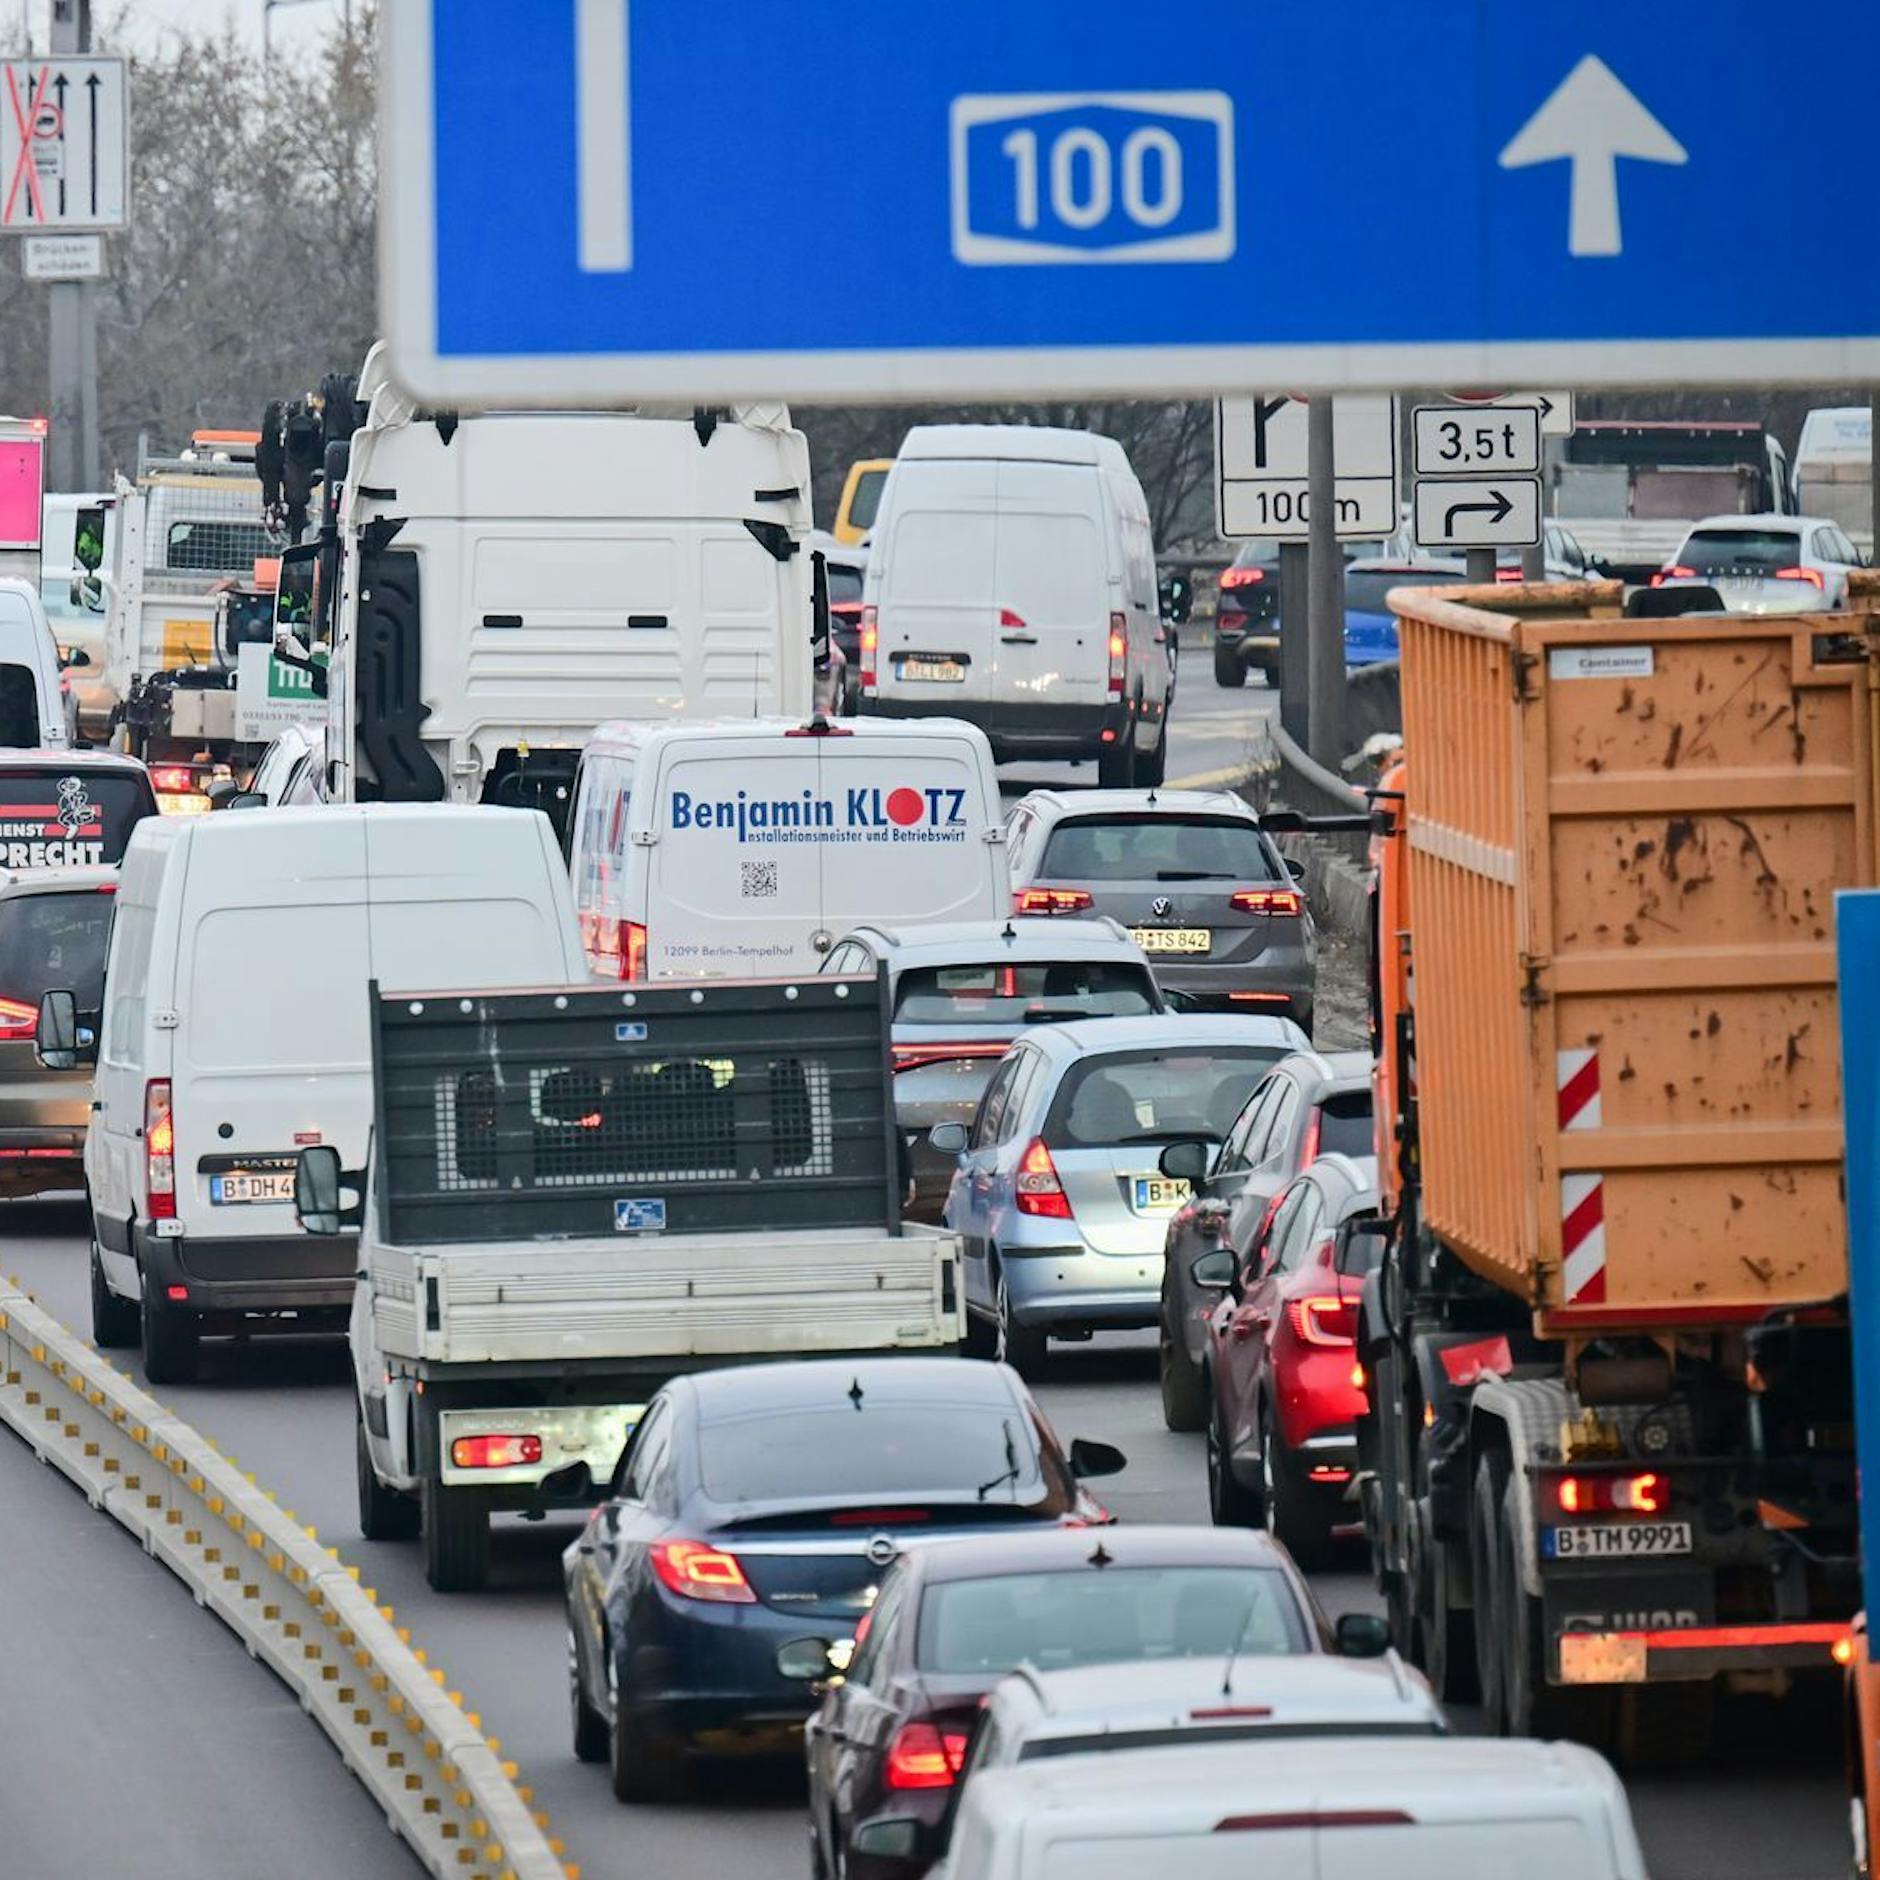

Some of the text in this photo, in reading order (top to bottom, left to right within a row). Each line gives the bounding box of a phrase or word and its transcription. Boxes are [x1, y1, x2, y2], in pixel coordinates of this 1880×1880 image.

[1002, 126, 1183, 230] 100
[672, 790, 833, 842] Benjamin
[866, 829, 888, 842] und
[893, 828, 965, 842] Betriebswirt
[1156, 933, 1175, 947] TS
[1178, 932, 1207, 947] 842
[702, 945, 794, 960] Berlin-Tempelhof
[224, 1181, 236, 1198] B
[251, 1179, 276, 1197] DH
[1150, 1183, 1161, 1202] B
[1558, 1526, 1688, 1553] B TM 9991
